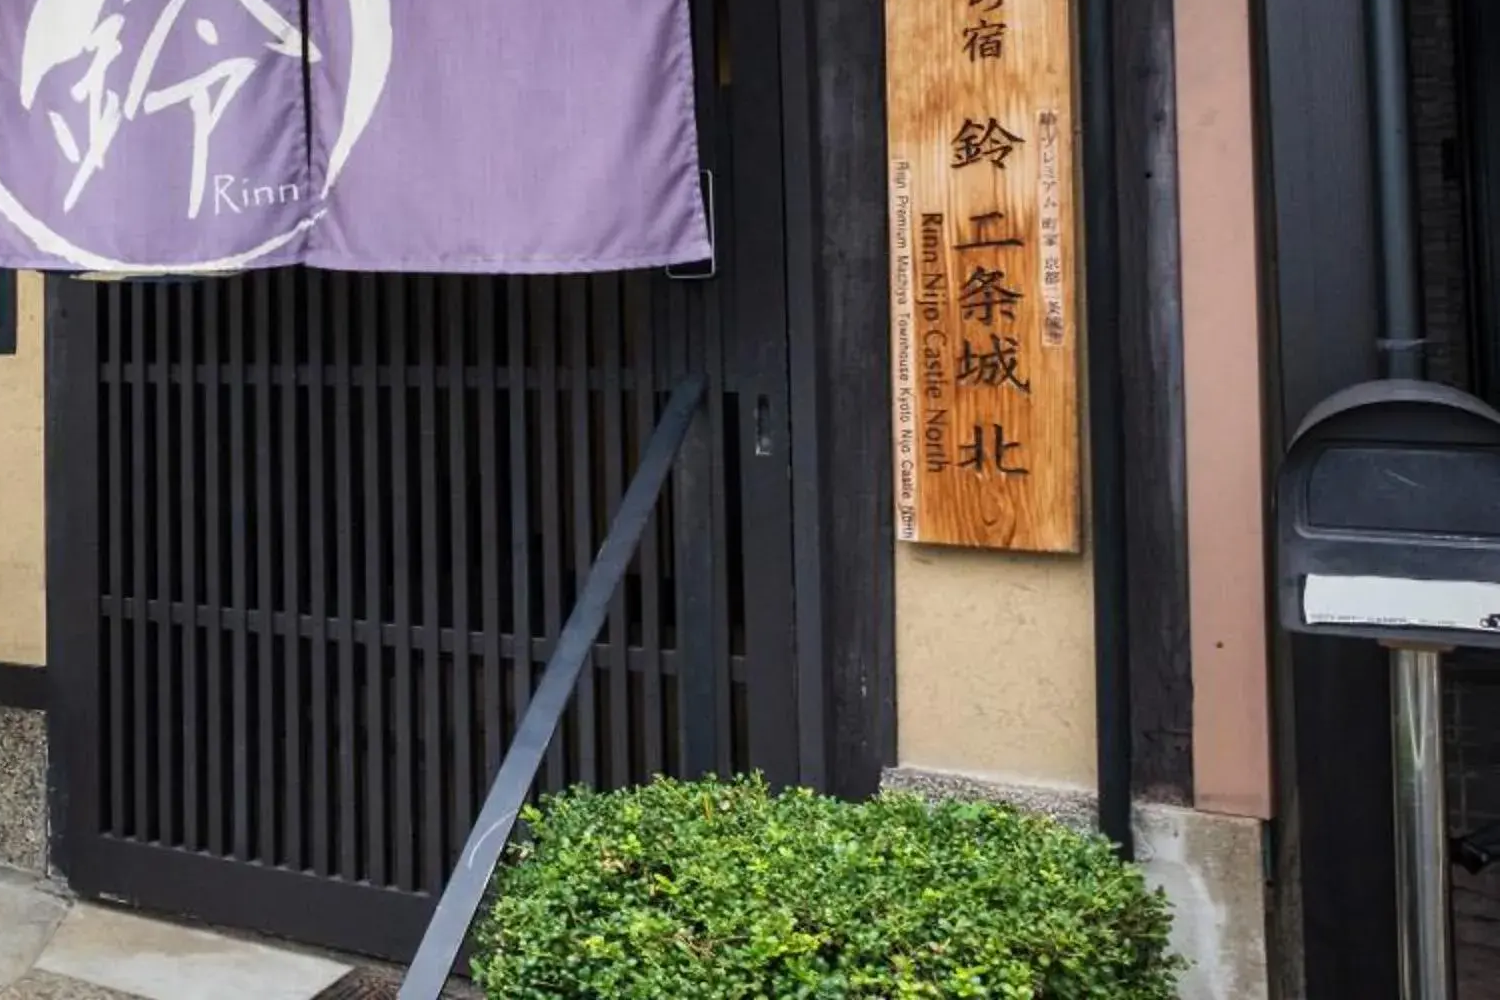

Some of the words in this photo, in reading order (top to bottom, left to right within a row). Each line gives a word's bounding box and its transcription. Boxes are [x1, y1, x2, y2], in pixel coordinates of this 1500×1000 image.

[950, 118, 1026, 170] 鈴
[212, 174, 300, 216] Rinn
[895, 195, 910, 248] Premium
[921, 213, 943, 263] Rinn
[896, 255, 910, 305] Machiya
[916, 272, 945, 322] Nijo
[897, 313, 911, 381] Townhouse
[923, 329, 948, 399] Castle
[953, 212, 1031, 475] 二条城北
[898, 387, 912, 423] Kyoto
[925, 408, 950, 473] North
[900, 459, 913, 499] Castle
